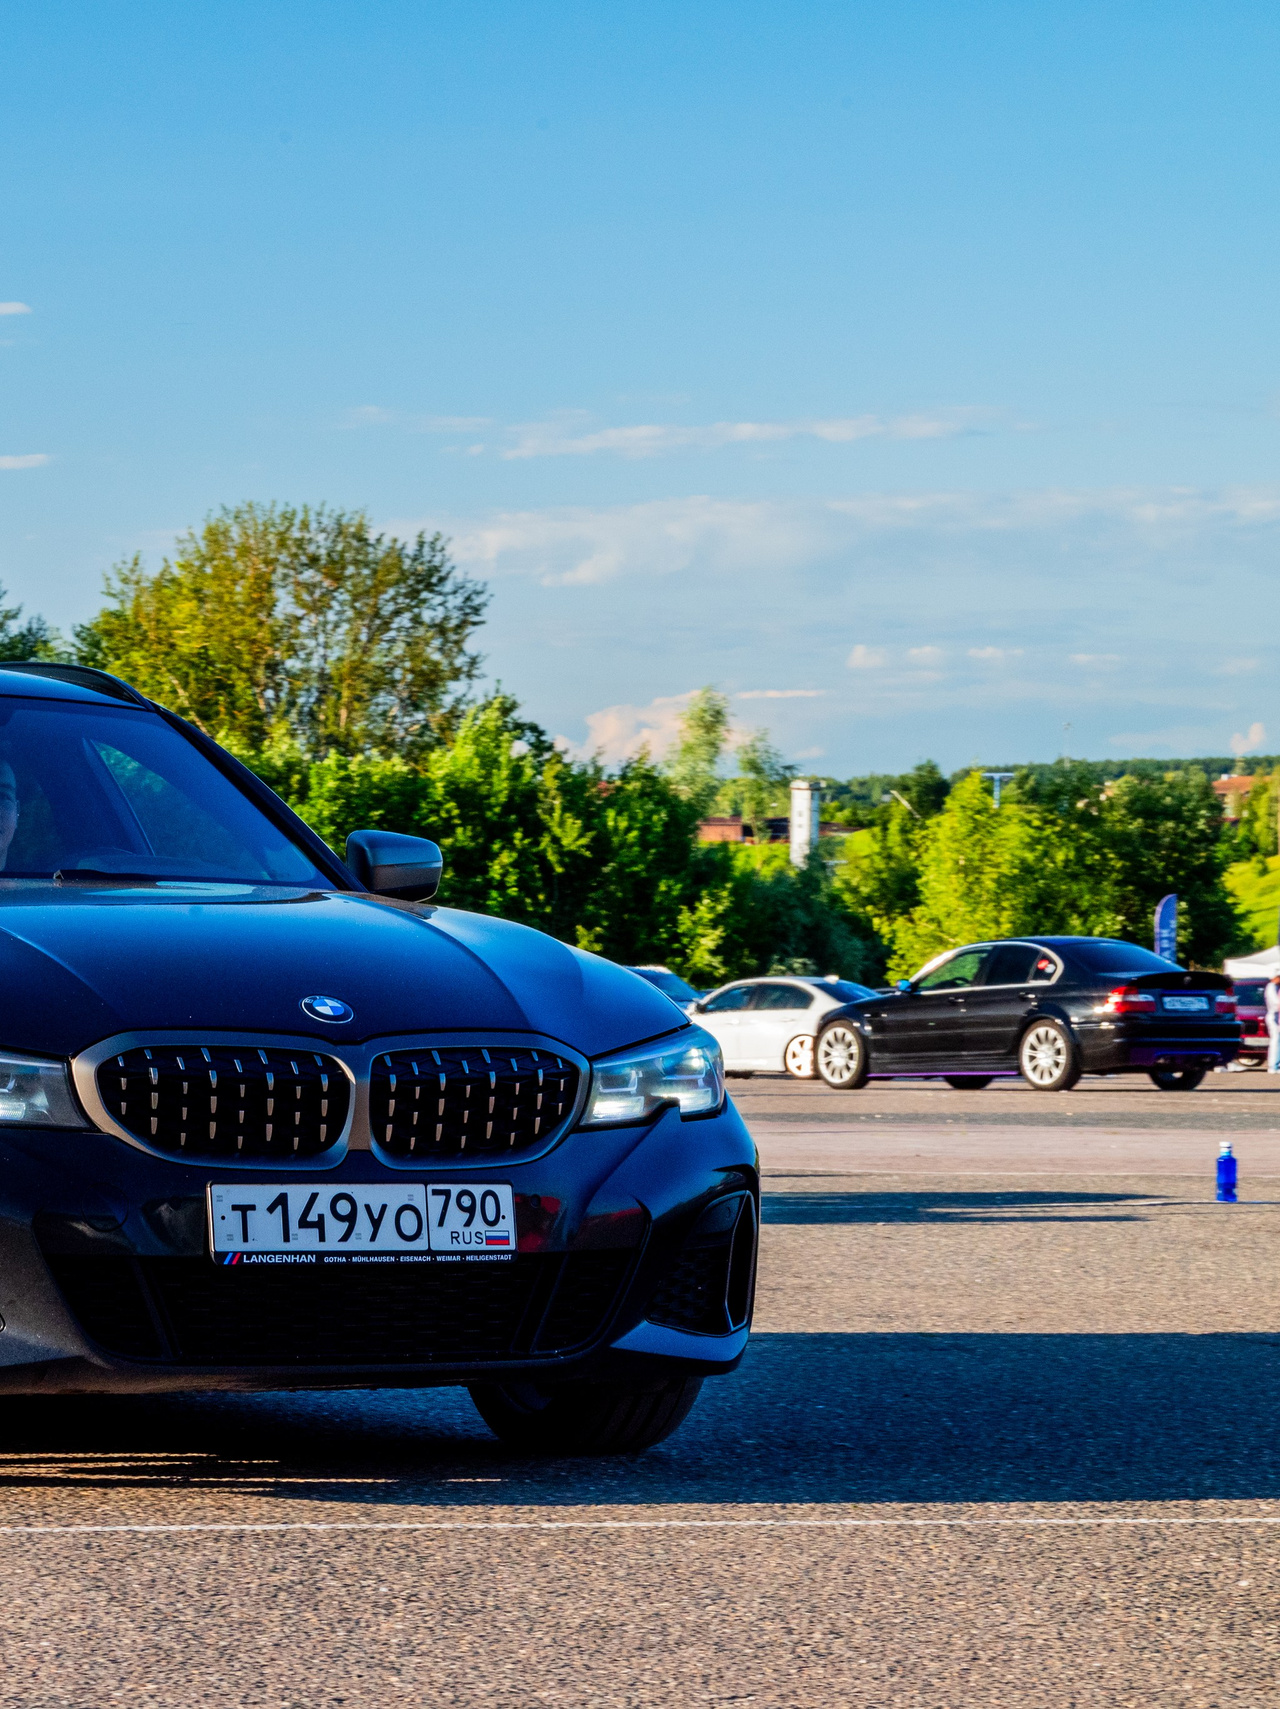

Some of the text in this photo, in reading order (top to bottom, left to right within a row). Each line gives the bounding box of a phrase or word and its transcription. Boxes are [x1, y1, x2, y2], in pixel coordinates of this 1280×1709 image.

[431, 1188, 501, 1228] 790
[450, 1230, 484, 1245] RUS
[243, 1253, 317, 1264] LANGENHAN
[323, 1255, 347, 1263] GOTHA
[351, 1254, 396, 1263] MÜHLHAUSEN
[436, 1254, 461, 1262] WEIMAR
